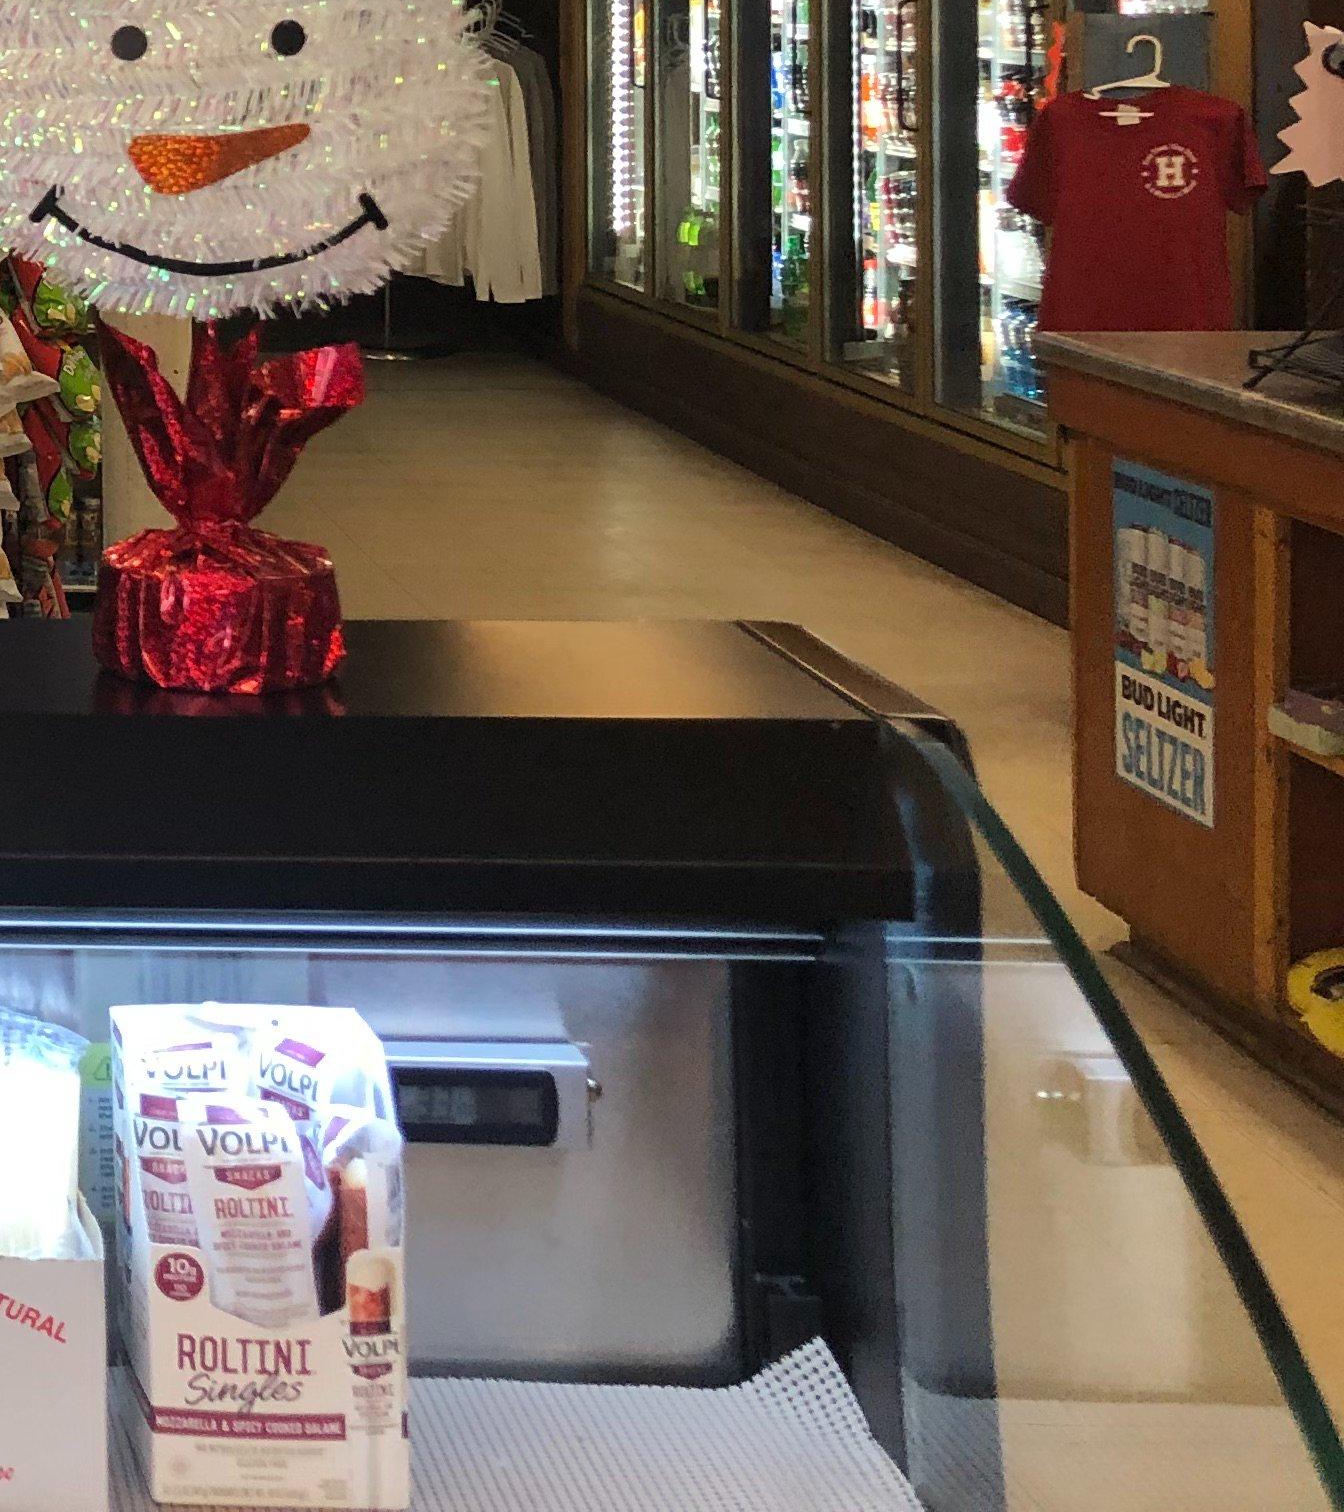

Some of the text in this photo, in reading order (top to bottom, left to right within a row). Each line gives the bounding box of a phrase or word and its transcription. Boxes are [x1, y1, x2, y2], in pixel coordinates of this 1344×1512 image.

[1154, 154, 1187, 187] H
[1121, 674, 1208, 741] BUD LIGHT
[1121, 710, 1208, 817] SELTZER
[195, 1127, 291, 1157] VOLPI
[214, 1196, 292, 1219] ROLTINI
[177, 1332, 315, 1377] ROLTINI
[184, 1372, 304, 1416] Singles
